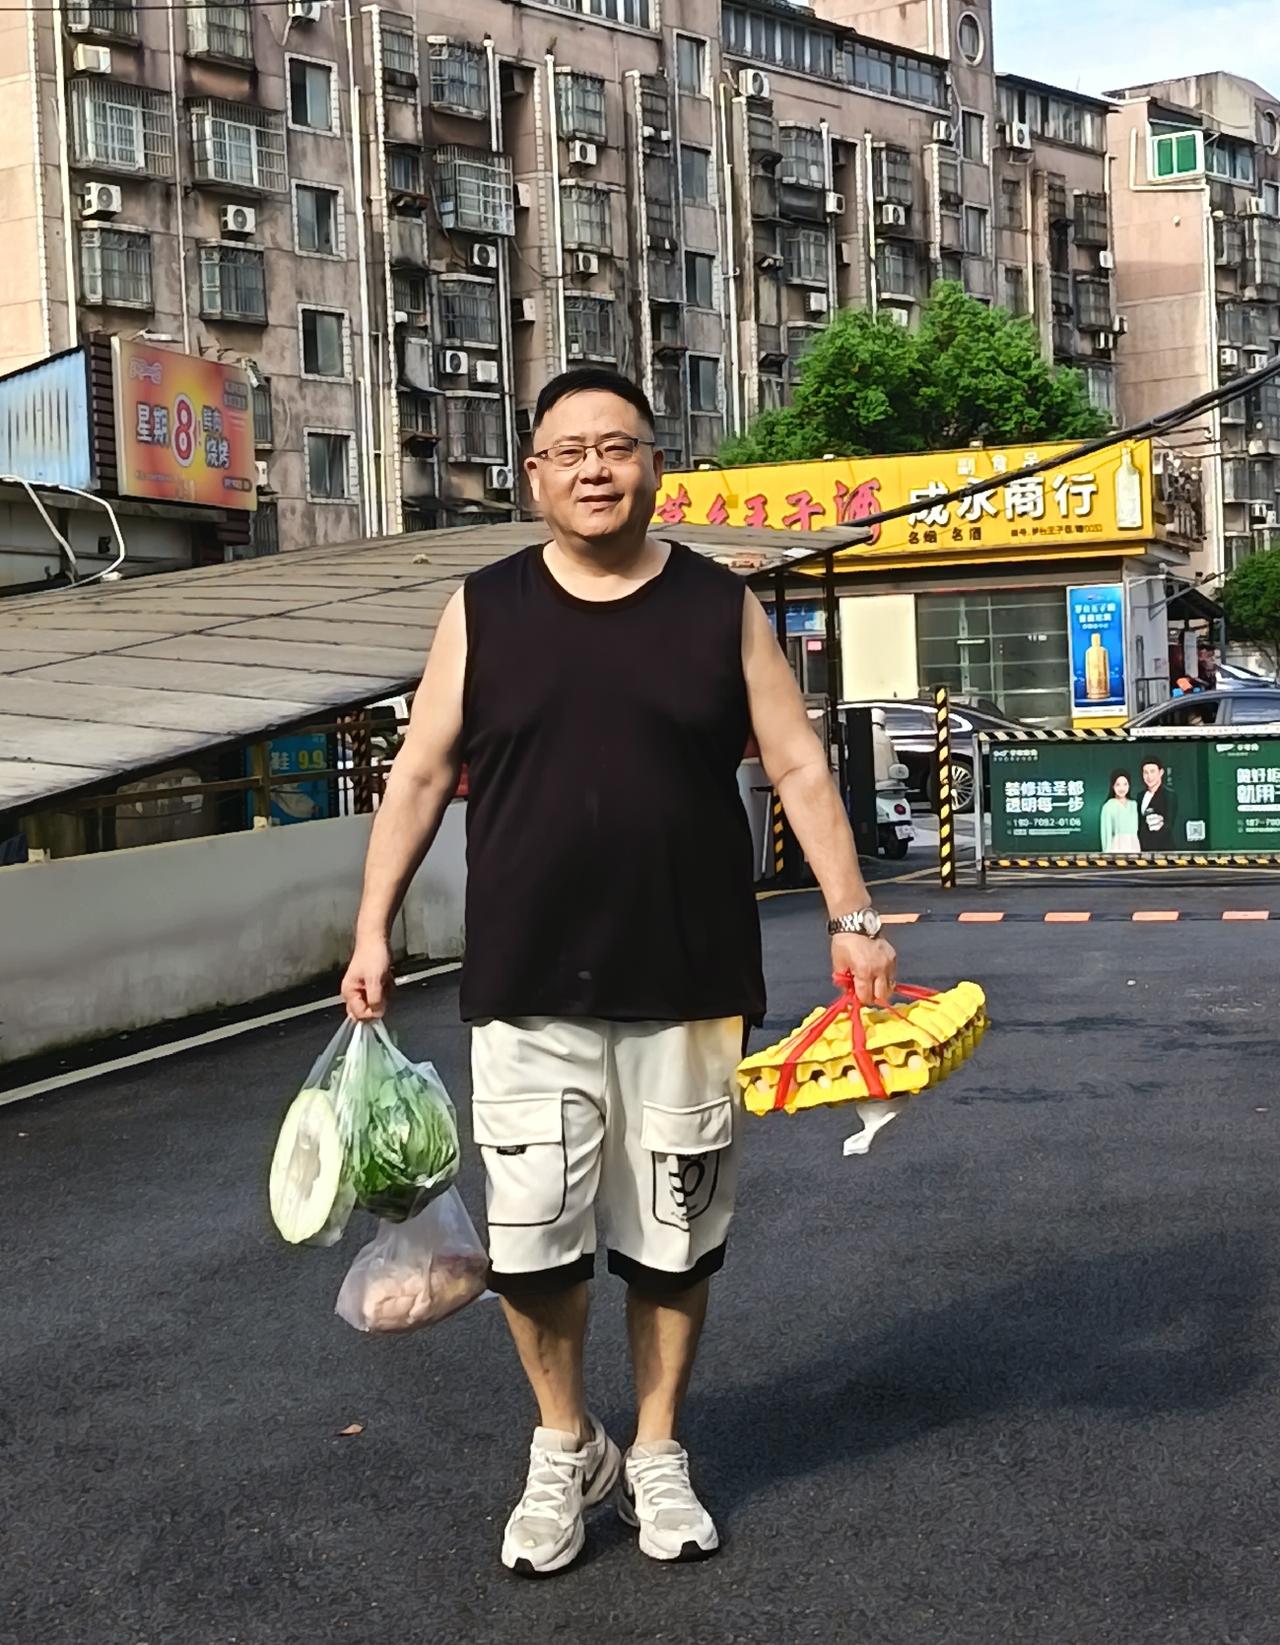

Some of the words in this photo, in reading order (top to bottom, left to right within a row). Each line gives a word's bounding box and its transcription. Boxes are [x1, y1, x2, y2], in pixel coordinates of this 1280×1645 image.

[1004, 780, 1084, 797] 装修选圣都
[1236, 784, 1280, 804] 就用
